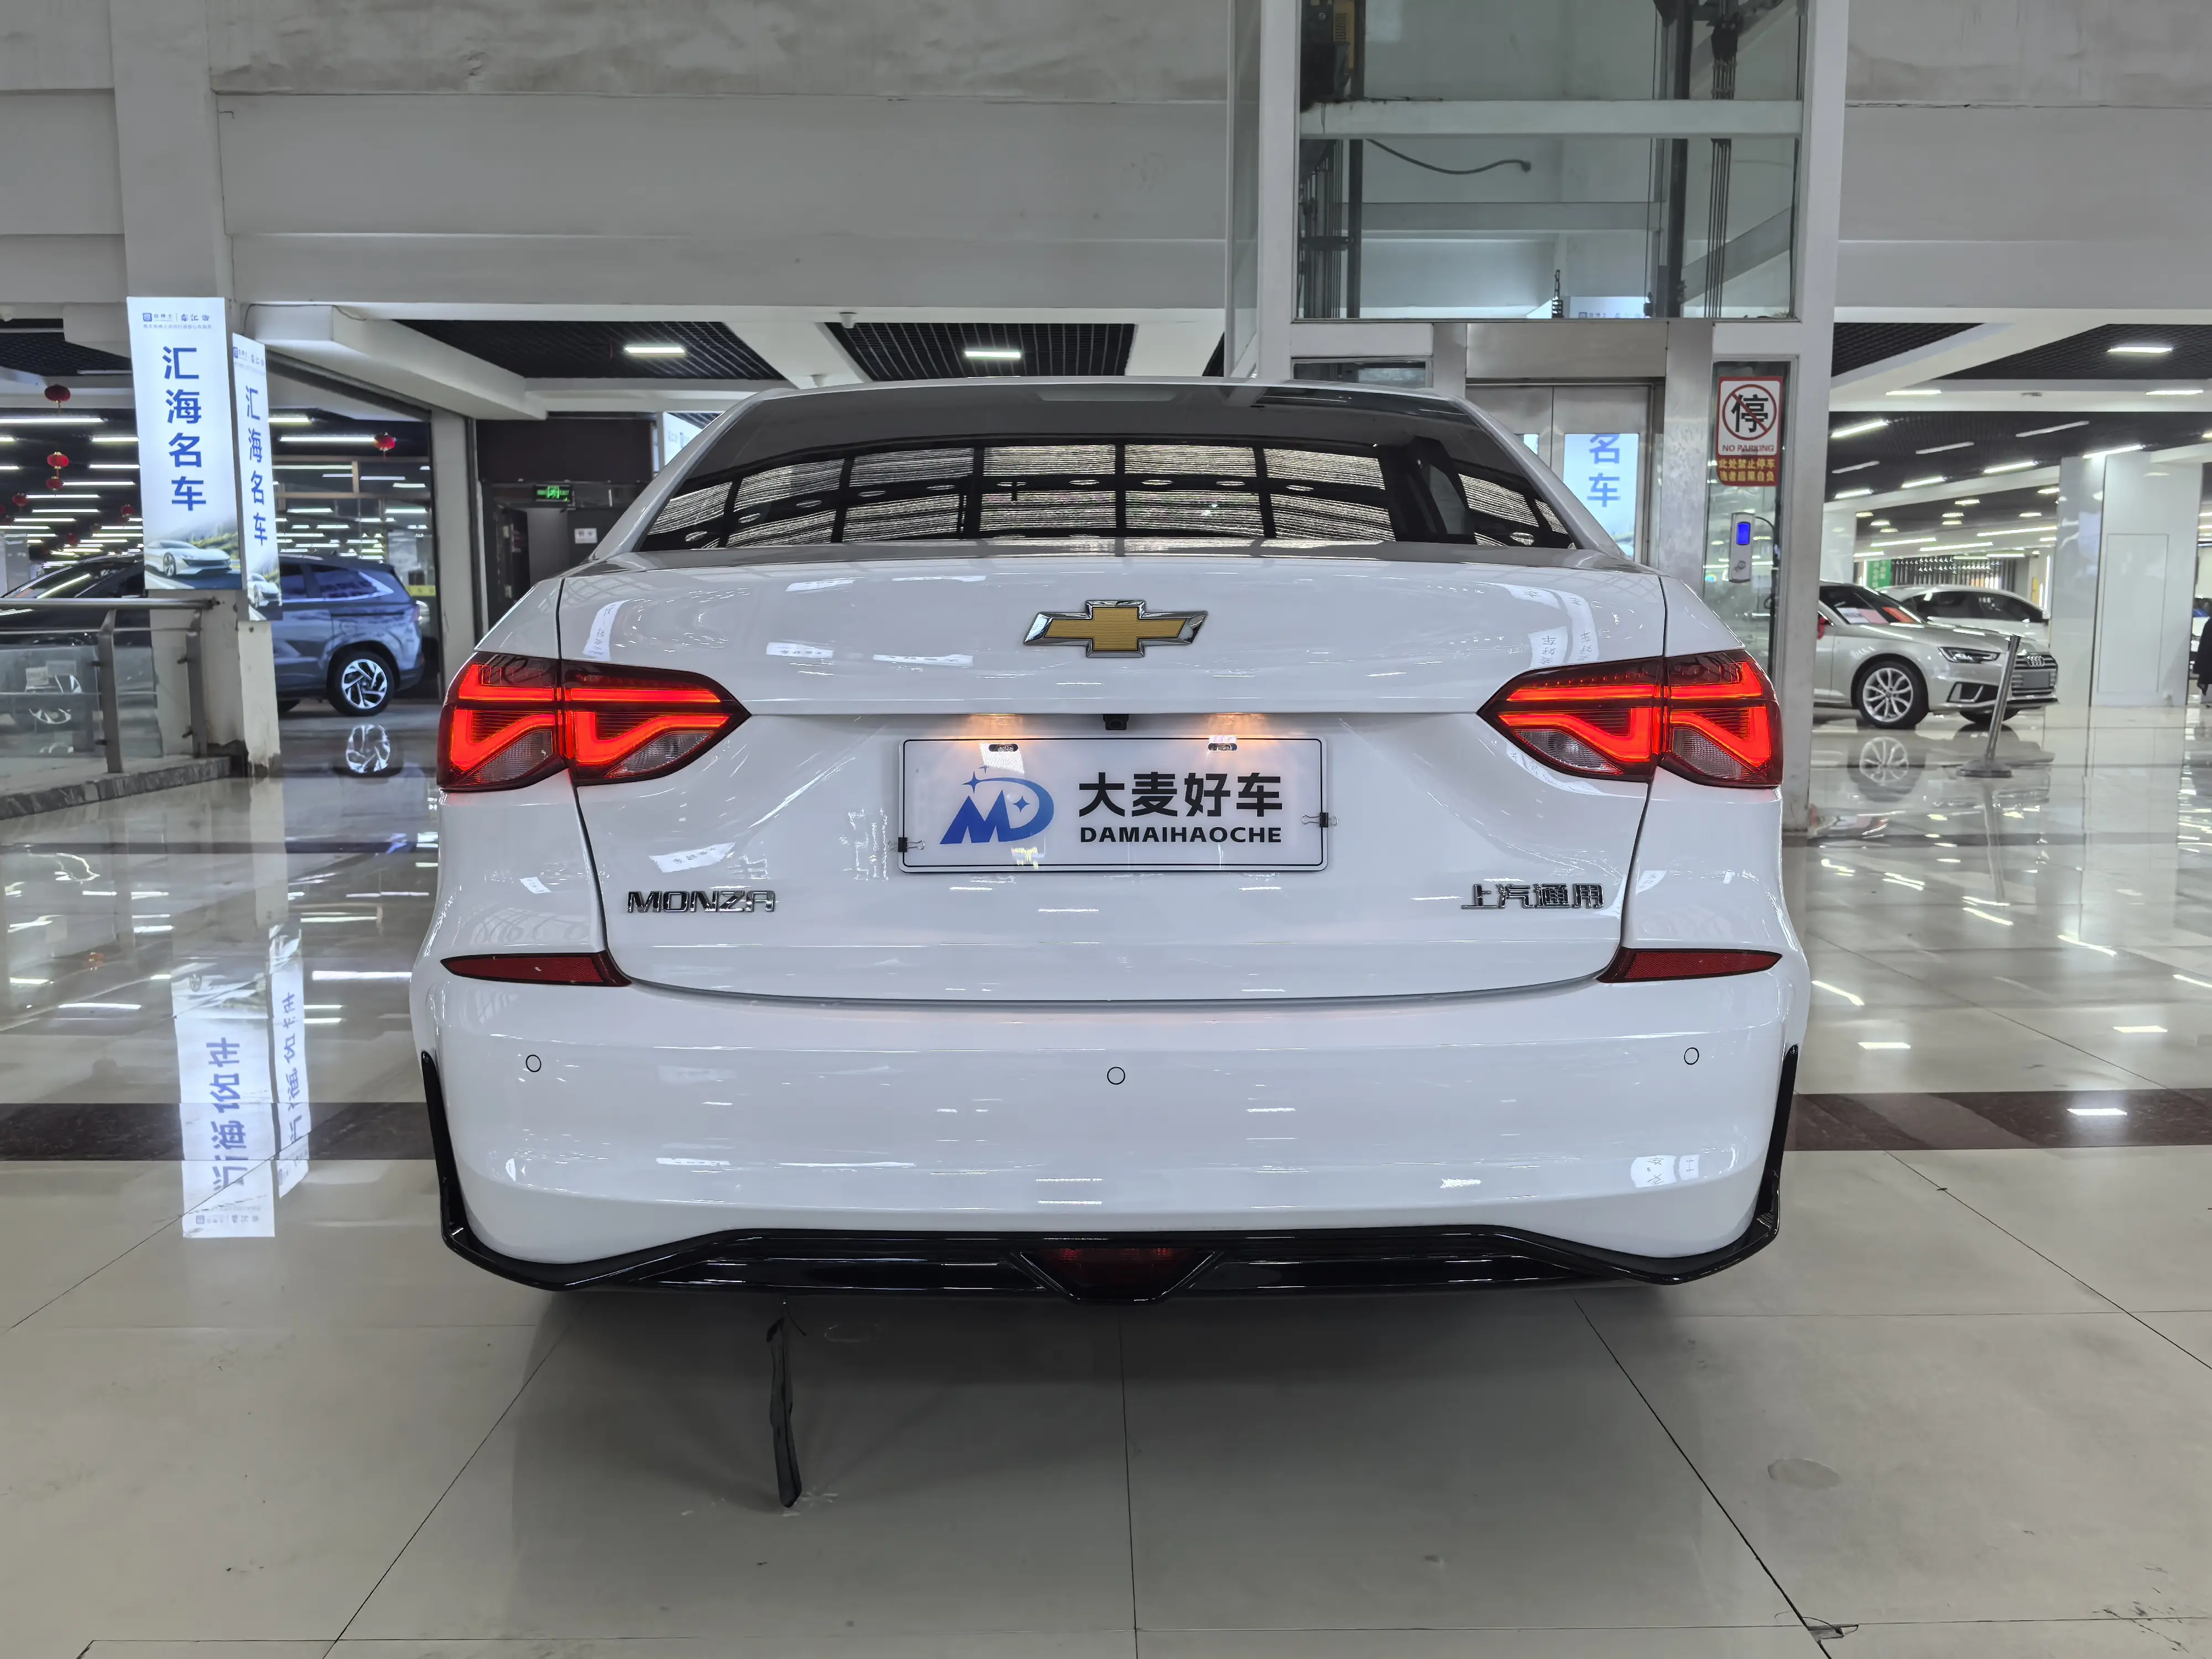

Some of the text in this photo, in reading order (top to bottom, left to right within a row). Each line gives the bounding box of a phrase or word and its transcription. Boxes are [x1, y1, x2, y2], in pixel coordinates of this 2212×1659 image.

[163, 346, 207, 511] 汇海名车
[1731, 394, 1768, 433] 停
[246, 387, 268, 546] 汇海名车
[1587, 434, 1621, 508] 名车
[1719, 458, 1775, 469] 此处禁止停车
[1079, 772, 1282, 817] 大麦好车
[1081, 827, 1281, 843] DAMAIHAOCHE
[627, 890, 776, 913] MONZA
[1461, 883, 1604, 910] 上汽通用
